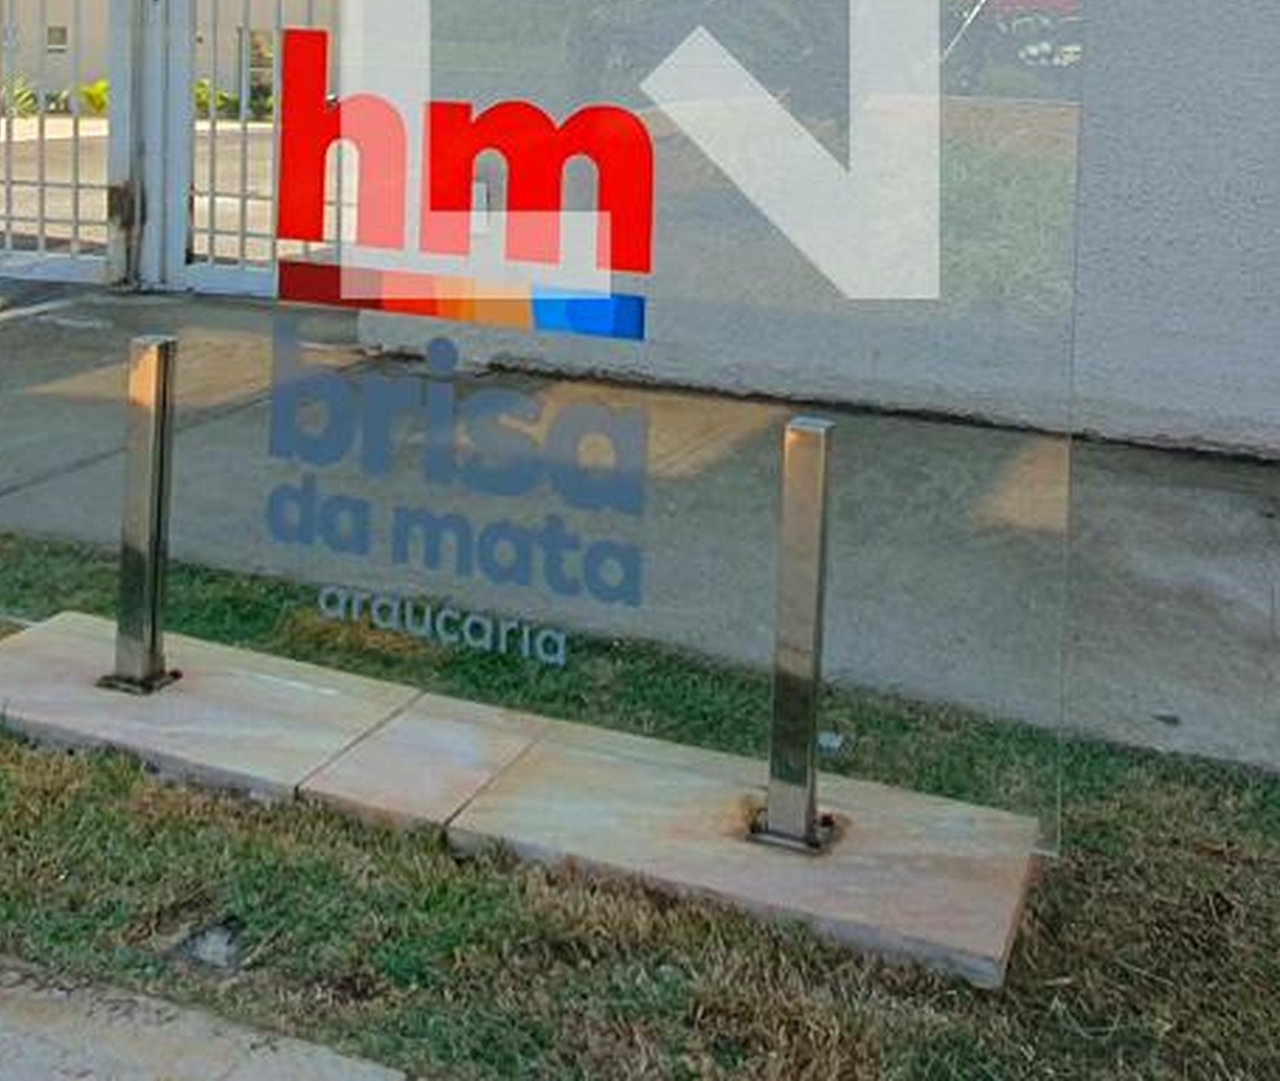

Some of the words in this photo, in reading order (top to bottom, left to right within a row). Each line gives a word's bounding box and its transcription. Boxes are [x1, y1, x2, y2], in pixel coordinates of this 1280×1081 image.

[278, 29, 654, 274] hm
[269, 313, 647, 515] brisa
[265, 474, 373, 558] da
[391, 503, 643, 609] mata
